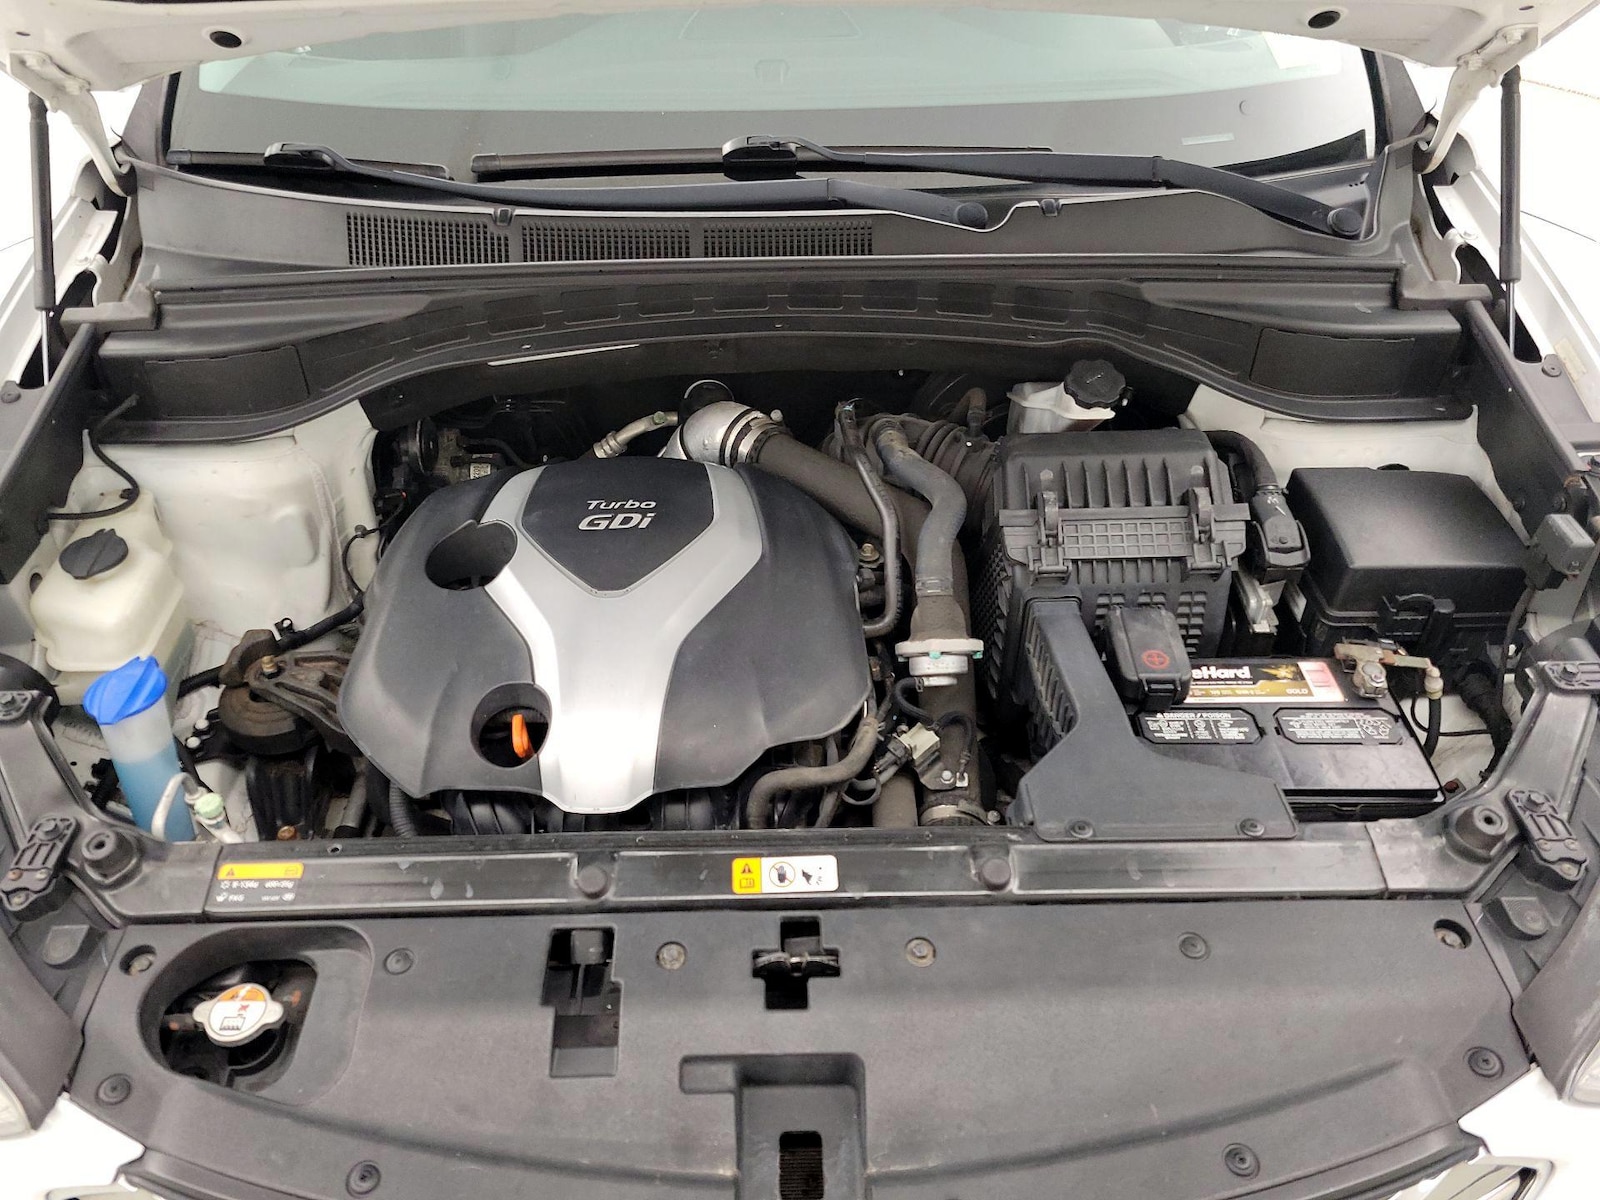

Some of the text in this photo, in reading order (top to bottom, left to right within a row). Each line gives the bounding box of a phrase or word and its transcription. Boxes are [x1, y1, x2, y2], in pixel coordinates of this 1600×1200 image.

[586, 499, 657, 510] Turbo
[578, 512, 657, 531] GDi
[1191, 665, 1251, 680] eHard
